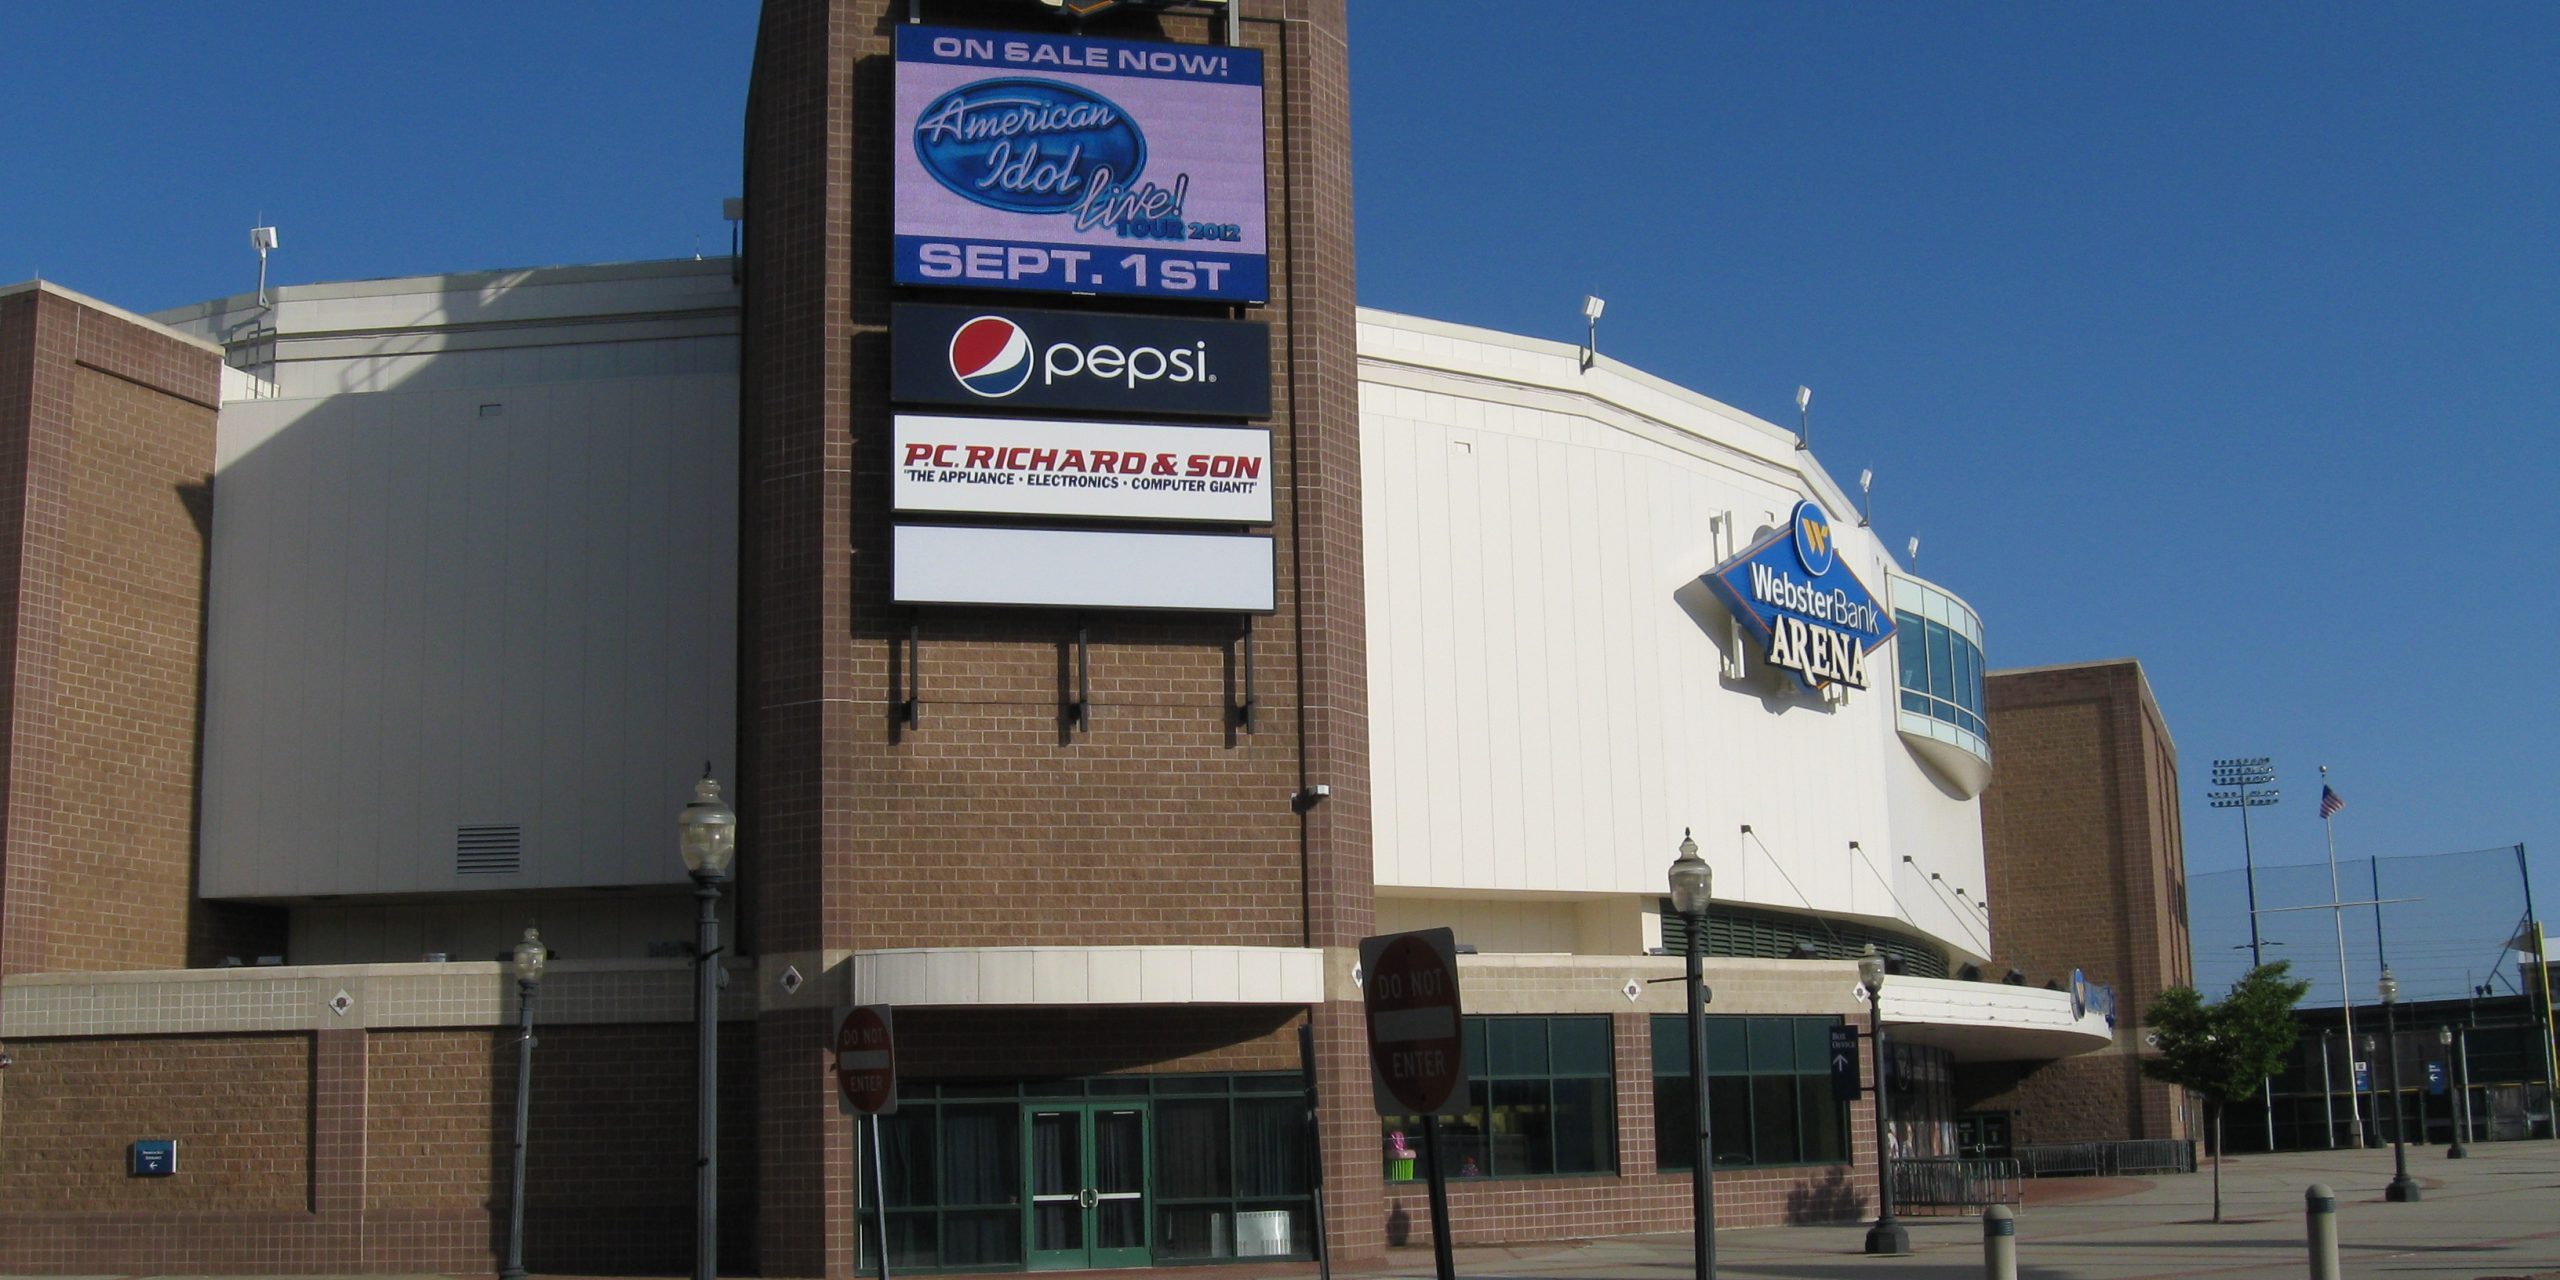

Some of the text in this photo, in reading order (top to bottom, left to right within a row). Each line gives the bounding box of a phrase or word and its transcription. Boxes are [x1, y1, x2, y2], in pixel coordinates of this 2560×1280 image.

[933, 36, 1228, 77] ON SALE NOW!
[918, 97, 1115, 142] American
[977, 140, 1082, 190] Idol
[1115, 218, 1241, 242] TOUR 2012
[918, 242, 1103, 285] SEPT.
[1044, 340, 1207, 389] pepsi
[964, 445, 1147, 475] RICHARD
[1150, 453, 1179, 476] &
[1185, 455, 1262, 479] SON
[938, 471, 1015, 485] APPLIANCE
[1027, 474, 1119, 488] ELECTRONICS
[1131, 477, 1205, 493] COMPUTER
[1770, 614, 1871, 688] ARENA
[1378, 968, 1443, 1000] DO NOT
[844, 1028, 883, 1045] DO NOT
[1392, 1050, 1446, 1078] ENTER
[850, 1075, 883, 1092] ENTER
